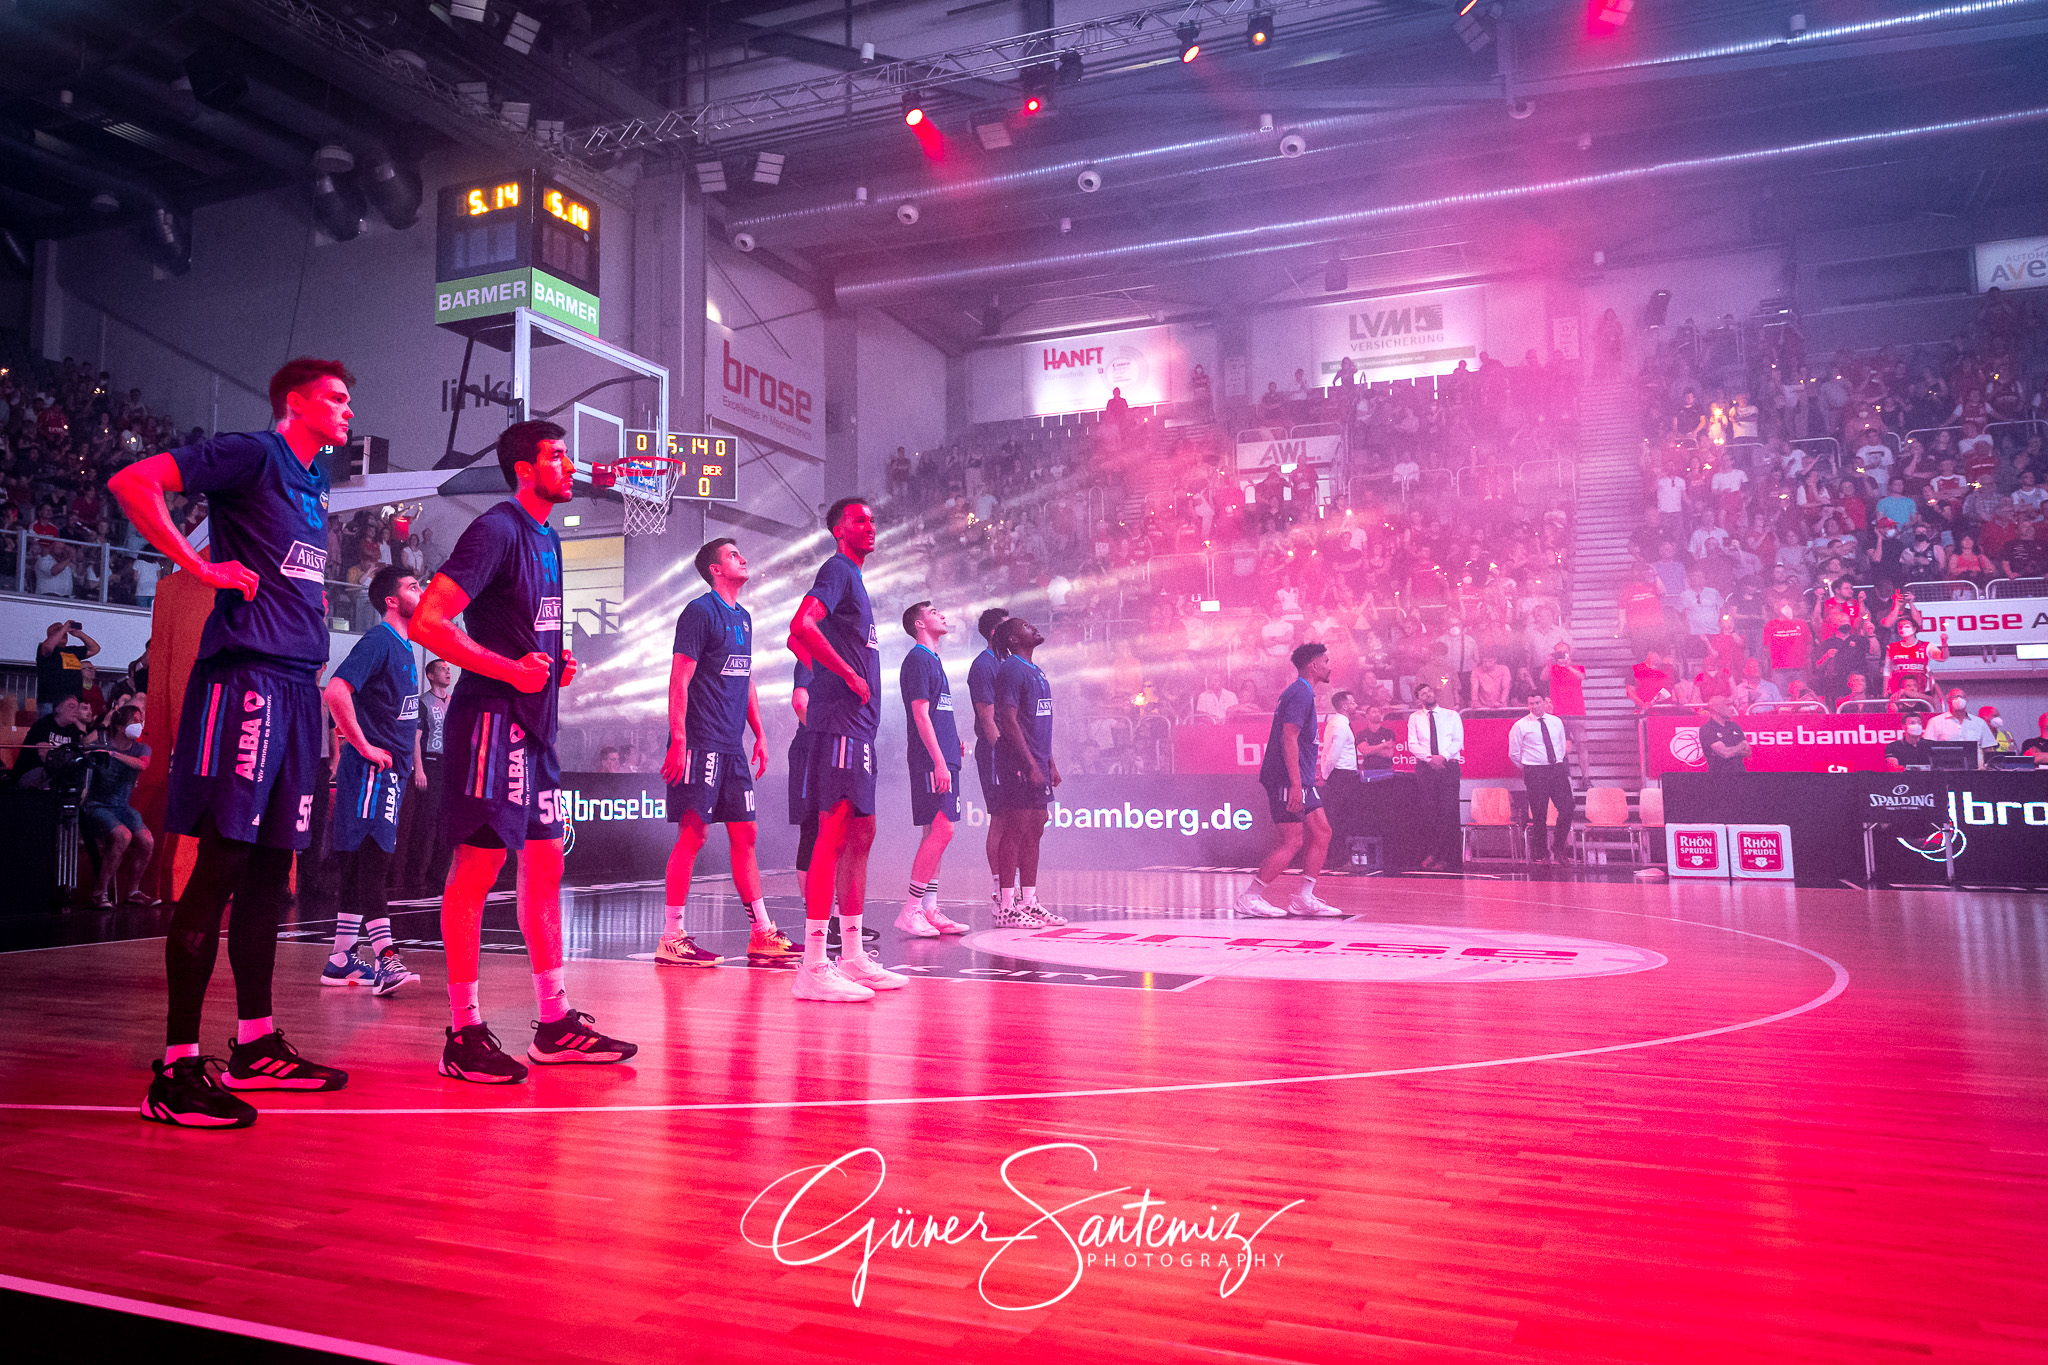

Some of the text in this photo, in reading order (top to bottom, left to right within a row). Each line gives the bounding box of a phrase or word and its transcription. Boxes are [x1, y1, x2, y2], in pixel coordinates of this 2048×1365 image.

[438, 280, 527, 311] BARMER
[534, 281, 597, 324] BARMER
[1349, 307, 1412, 340] LVM
[1350, 333, 1444, 352] VERSICHERUNG
[1043, 346, 1103, 370] HANFT
[723, 339, 812, 424] brose
[723, 395, 760, 420] Excellence
[770, 414, 812, 441] Mechatronics
[637, 434, 647, 451] 0
[715, 440, 726, 456] 0
[702, 464, 723, 476] BER
[698, 477, 710, 496] 0
[1797, 725, 1906, 744] bamber
[235, 718, 263, 781] ALBA
[260, 737, 269, 766] nennen
[257, 769, 265, 782] Wir
[507, 747, 525, 806] ALBA
[704, 752, 716, 787] ALBA
[384, 787, 397, 824] ALBA
[1869, 793, 1937, 808] SPALDING
[968, 801, 1253, 836] bbamberg.de
[1680, 835, 1712, 847] RHÖN
[1680, 847, 1714, 855] SPRUDEL
[1743, 836, 1777, 848] RHÖN
[1743, 848, 1778, 856] SPRUDEL
[1030, 927, 1578, 961] brose
[958, 968, 1128, 981] CITY
